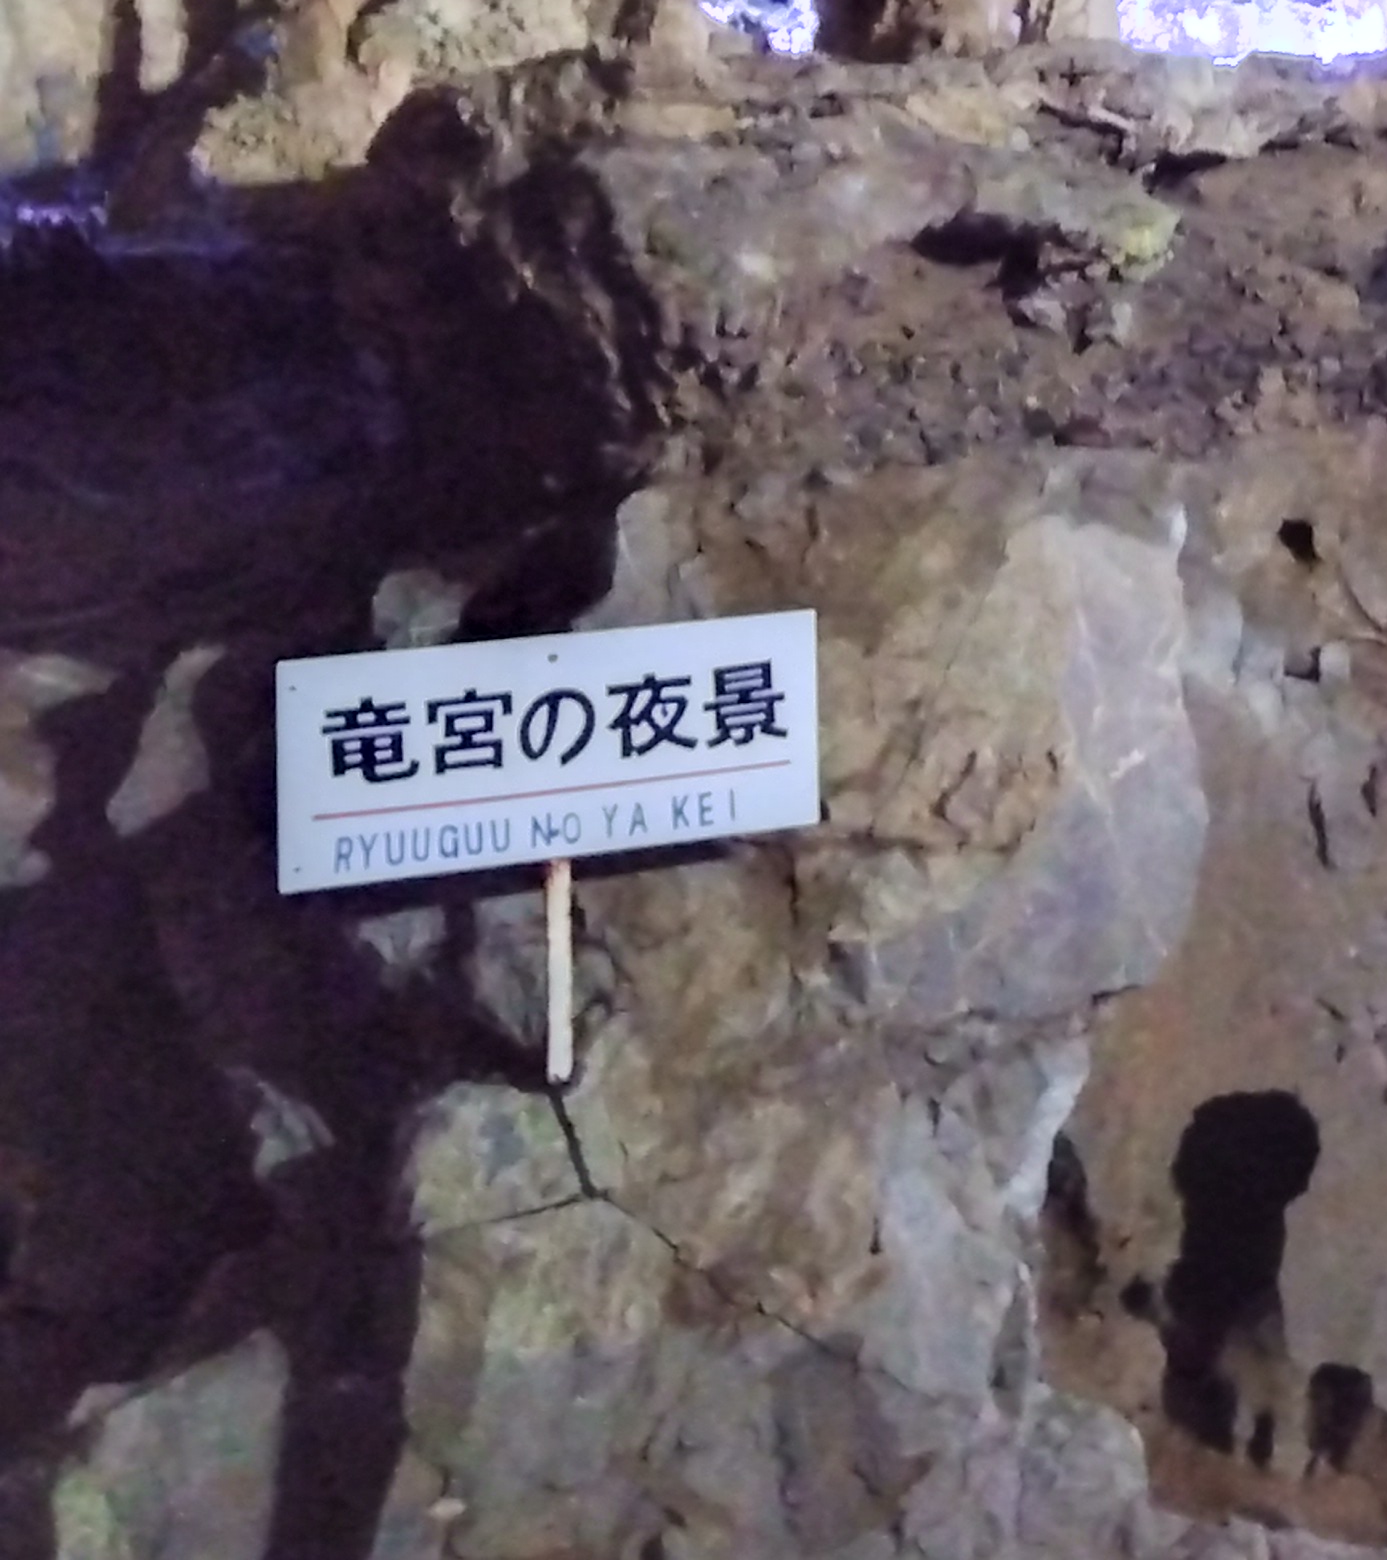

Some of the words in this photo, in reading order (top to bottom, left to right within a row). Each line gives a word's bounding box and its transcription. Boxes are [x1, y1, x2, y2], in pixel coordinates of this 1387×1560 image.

[322, 659, 788, 783] 竜宮の夜景
[333, 817, 511, 874] RYUUGUU
